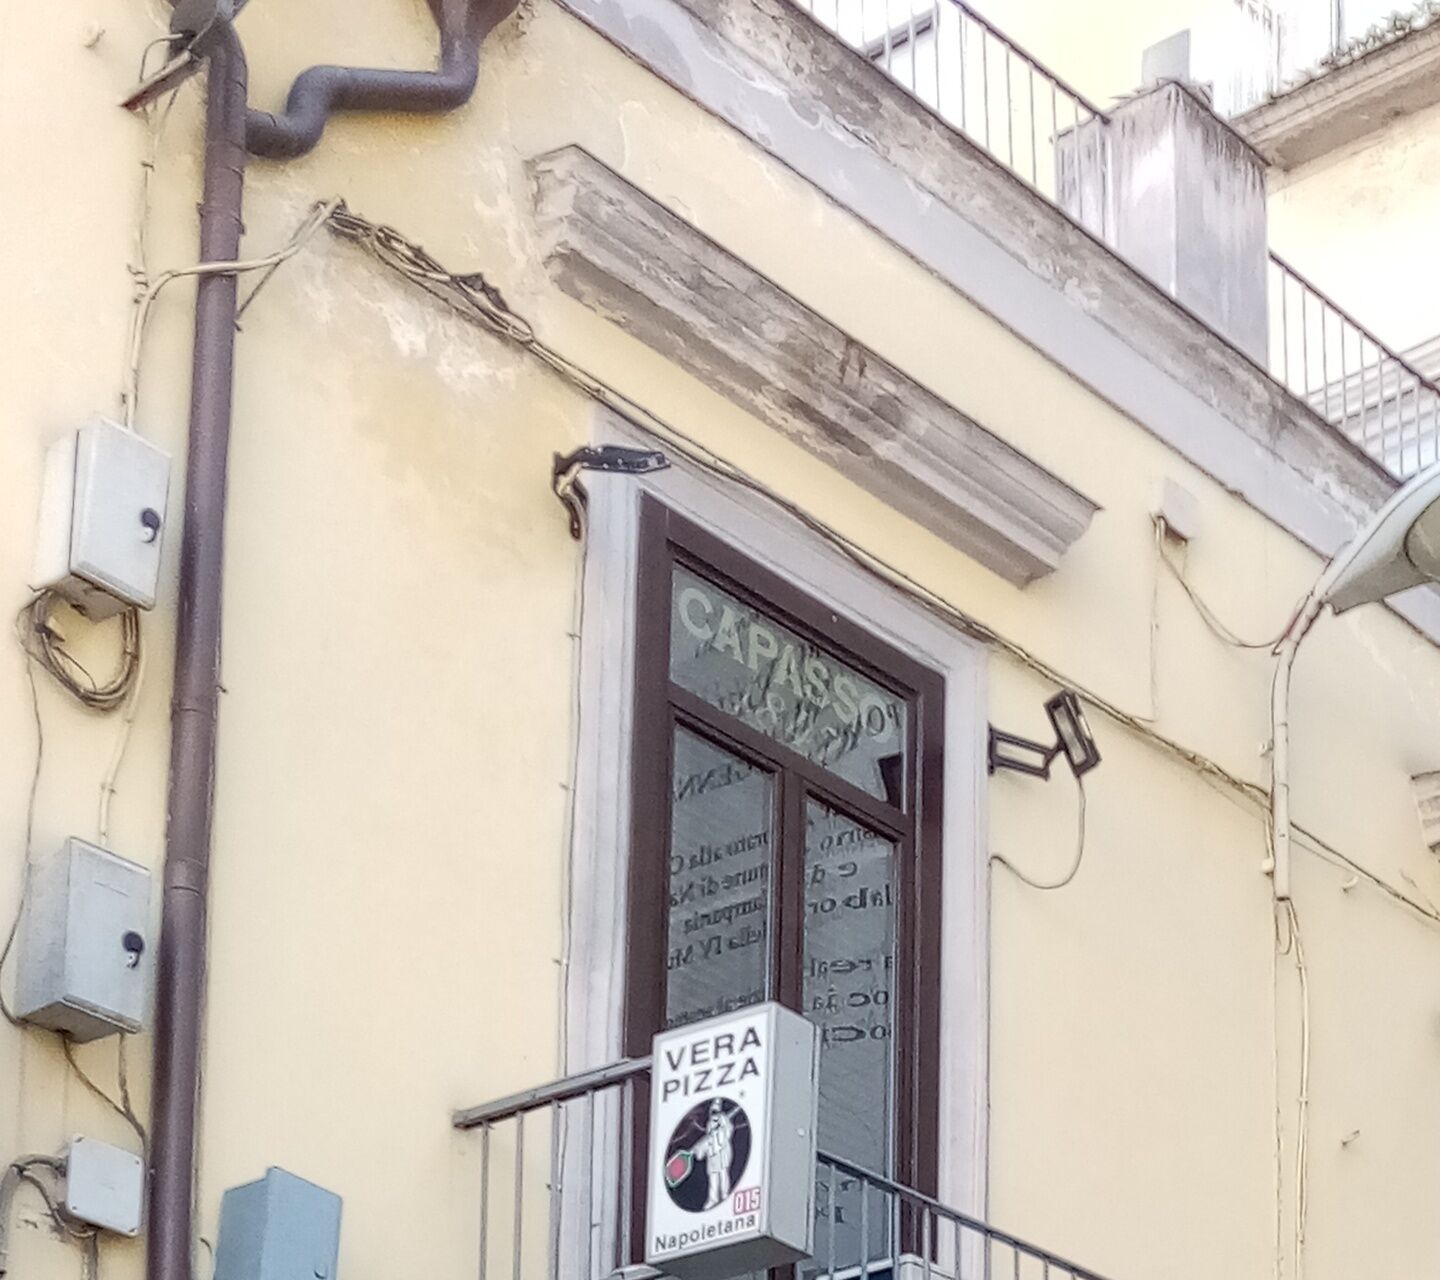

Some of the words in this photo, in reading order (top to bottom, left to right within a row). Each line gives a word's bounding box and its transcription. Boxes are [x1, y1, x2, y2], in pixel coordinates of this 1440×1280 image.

[678, 587, 888, 744] CAPASSO
[666, 1026, 762, 1072] VERA
[662, 1057, 760, 1103] PIZZA
[654, 1215, 756, 1252] Napoletana
